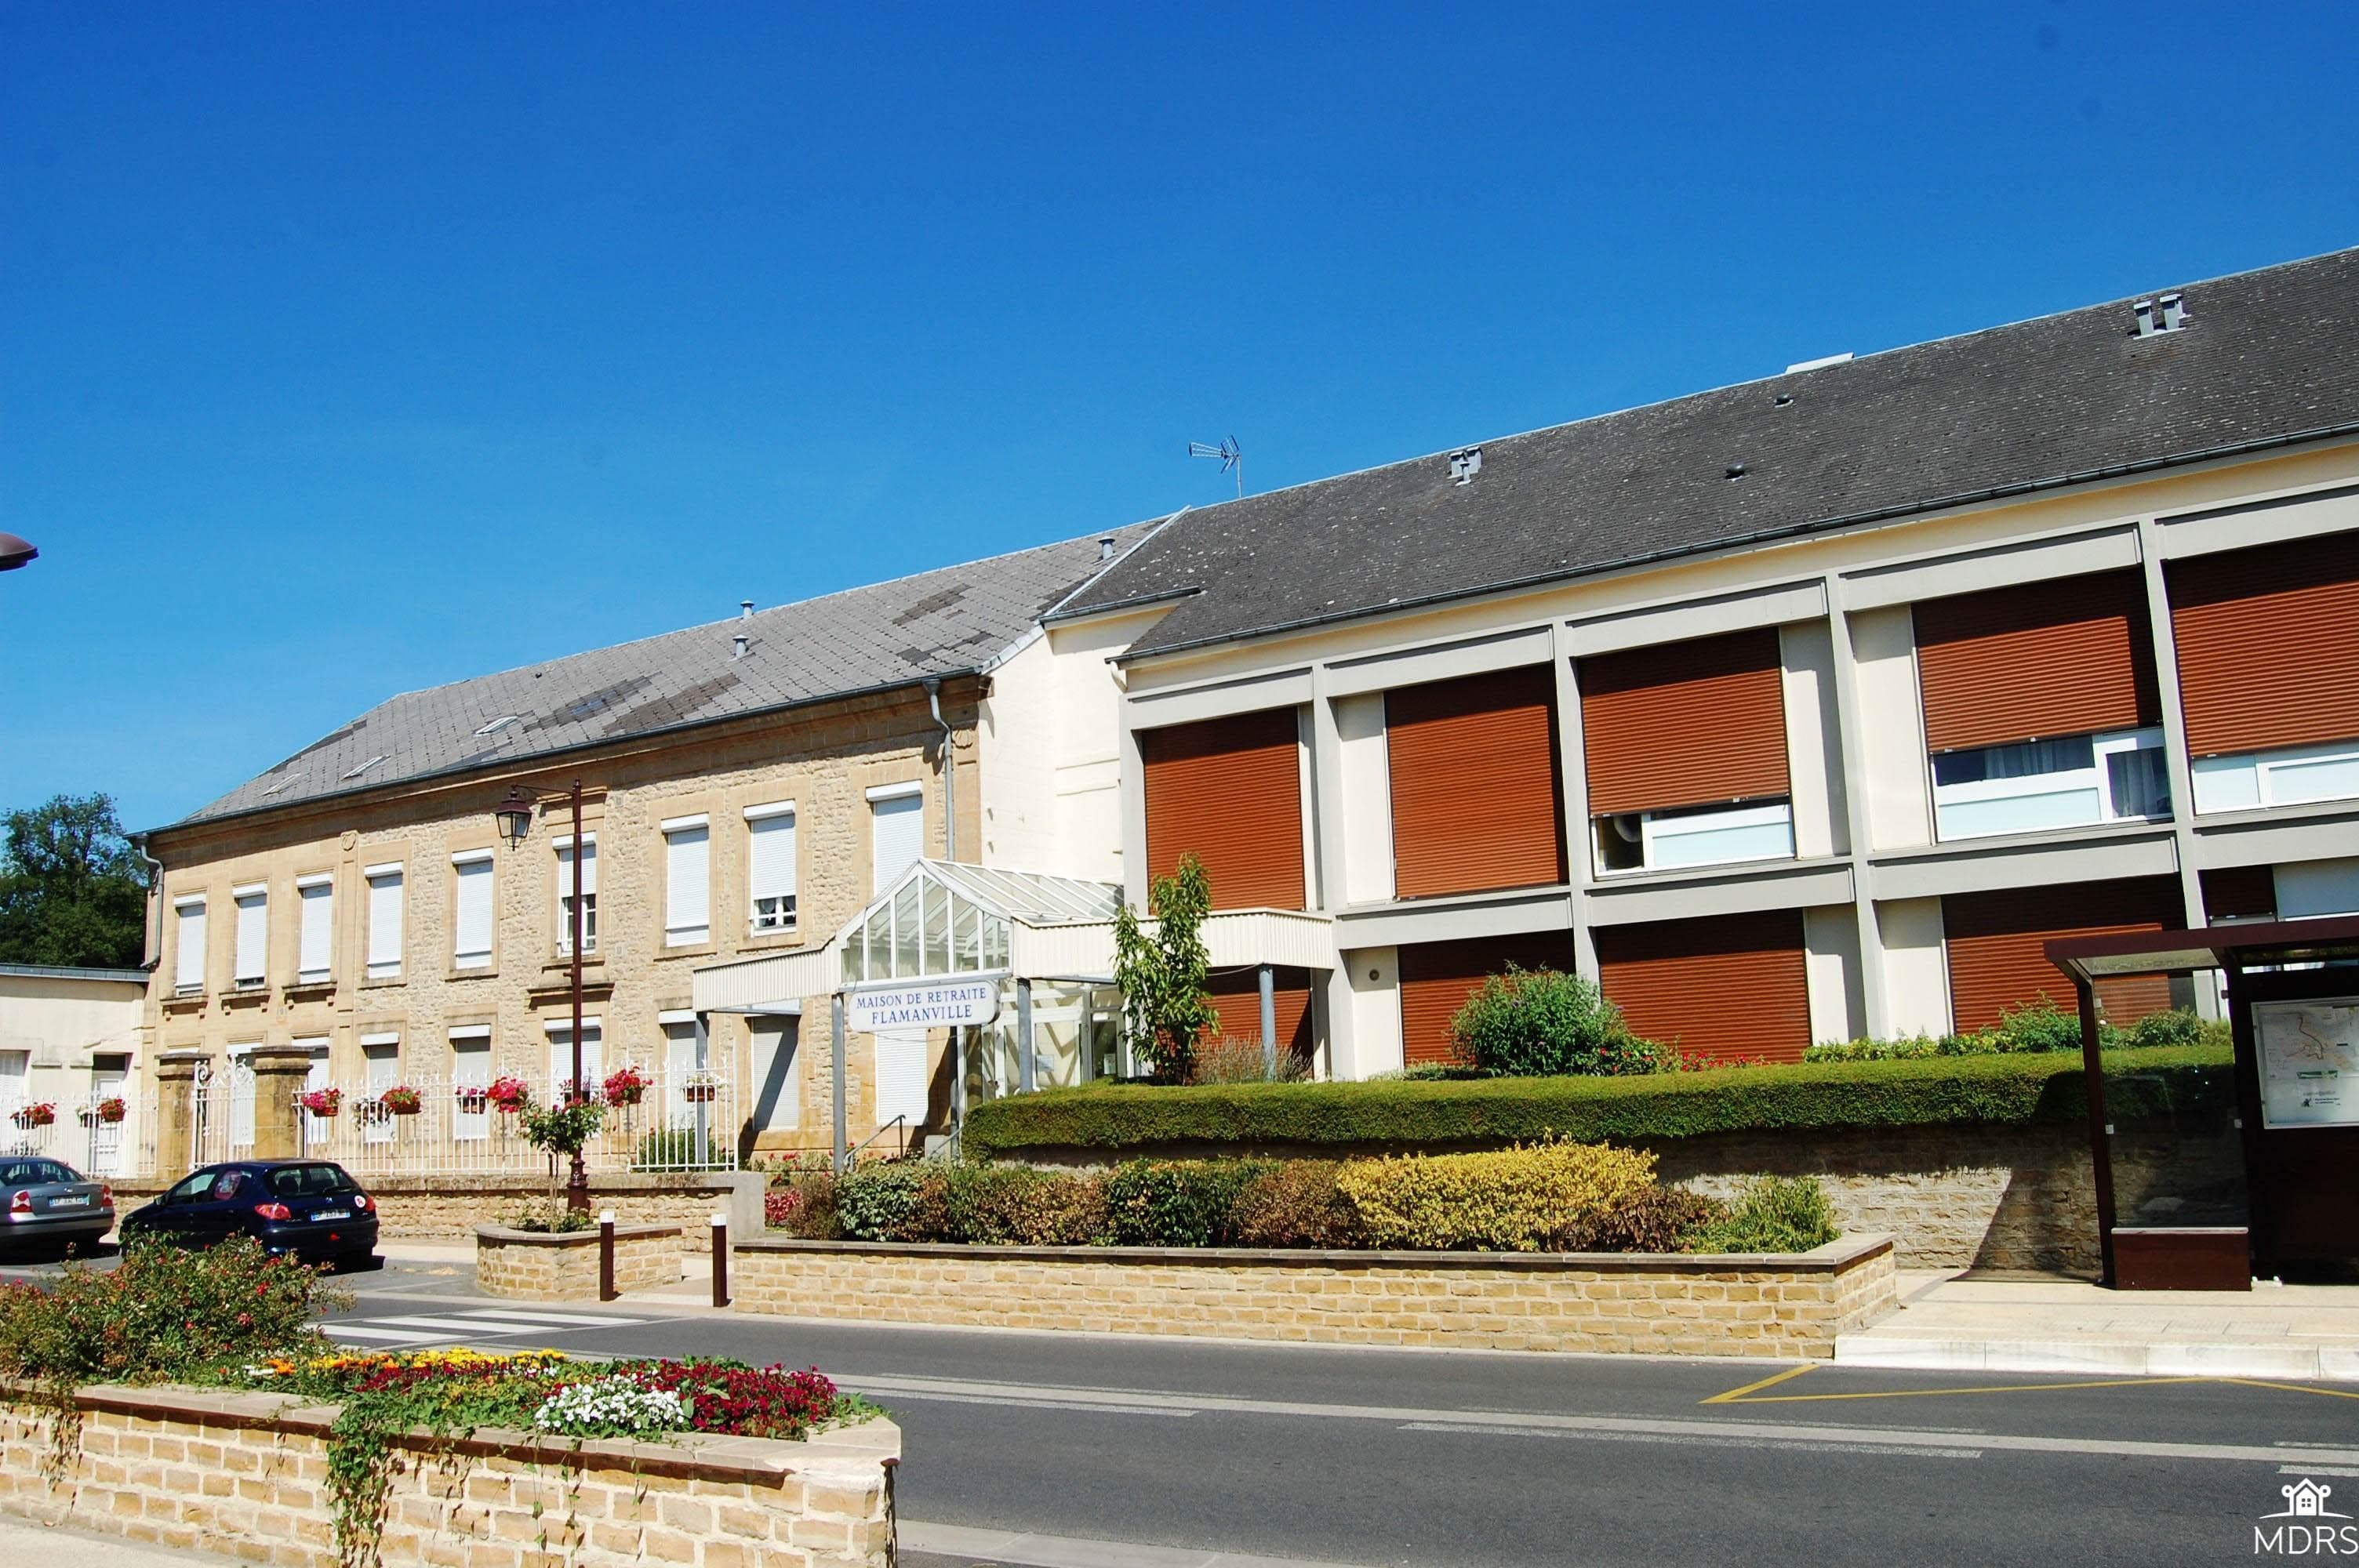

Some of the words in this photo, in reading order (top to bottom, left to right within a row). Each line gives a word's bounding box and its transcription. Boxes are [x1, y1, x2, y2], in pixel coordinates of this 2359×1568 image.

[857, 995, 902, 1008] MAISON
[907, 993, 921, 1004] DE
[928, 988, 986, 1003] RETRAITE
[872, 1005, 972, 1024] FLAMANVILLE
